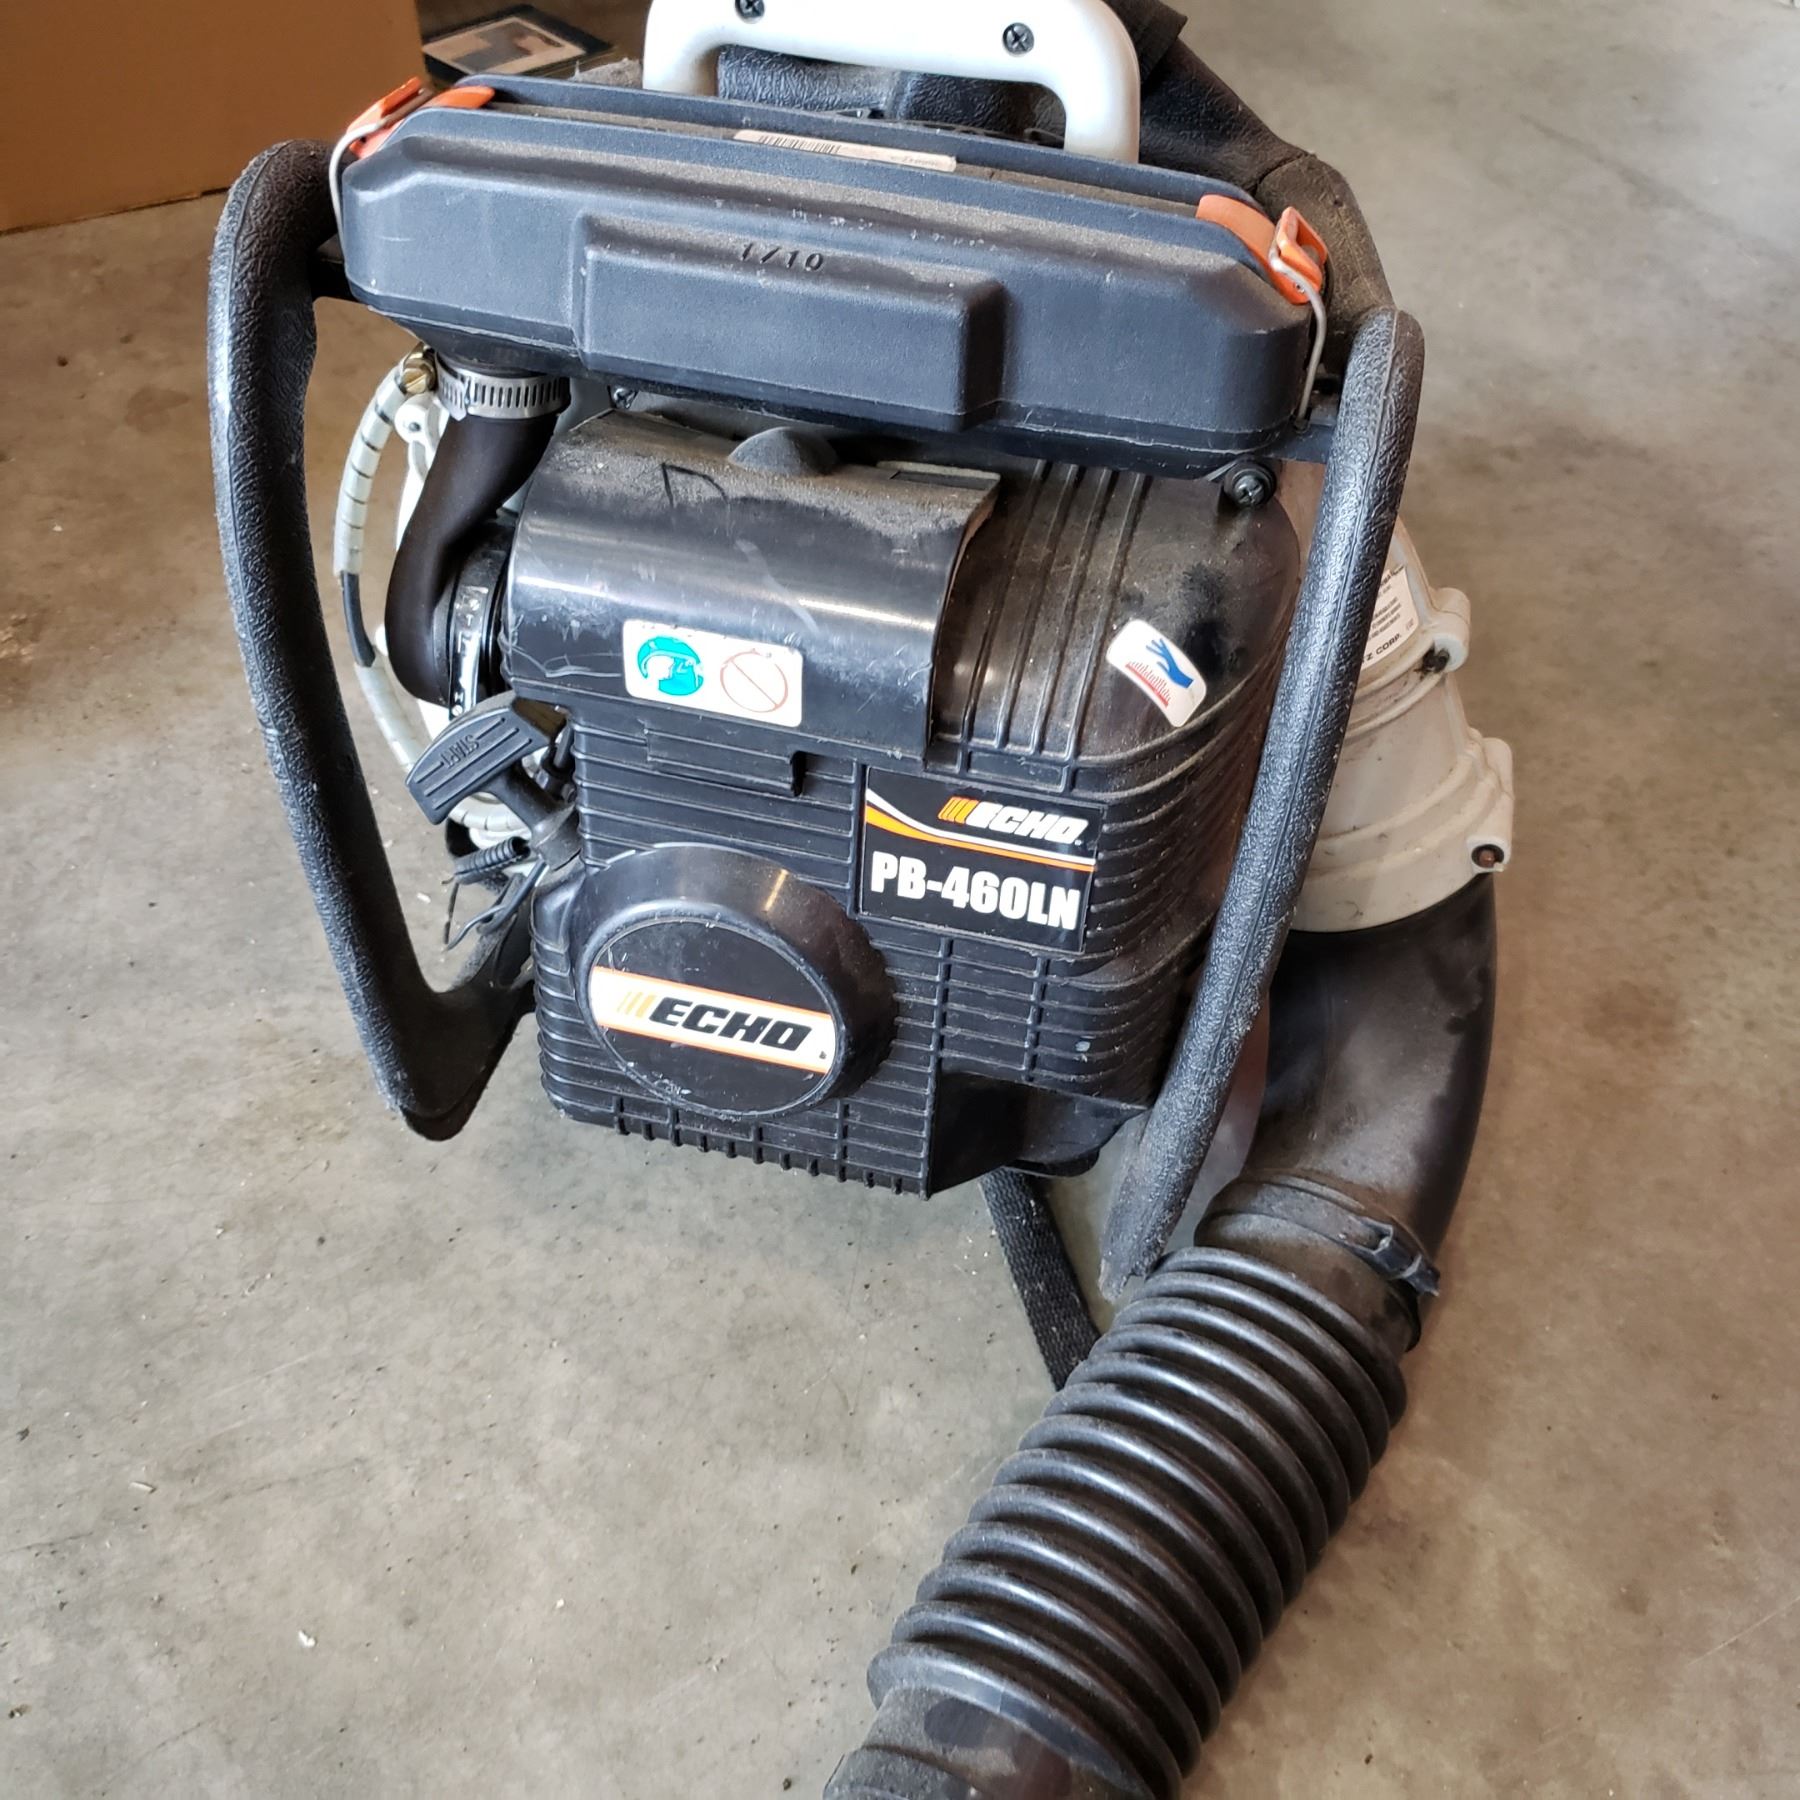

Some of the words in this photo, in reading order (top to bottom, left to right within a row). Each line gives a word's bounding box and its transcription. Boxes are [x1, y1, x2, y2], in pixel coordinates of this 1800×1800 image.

[441, 734, 480, 768] START
[965, 801, 1089, 845] ECHO
[870, 850, 1081, 930] PB-460LN
[649, 996, 812, 1051] ECHO
